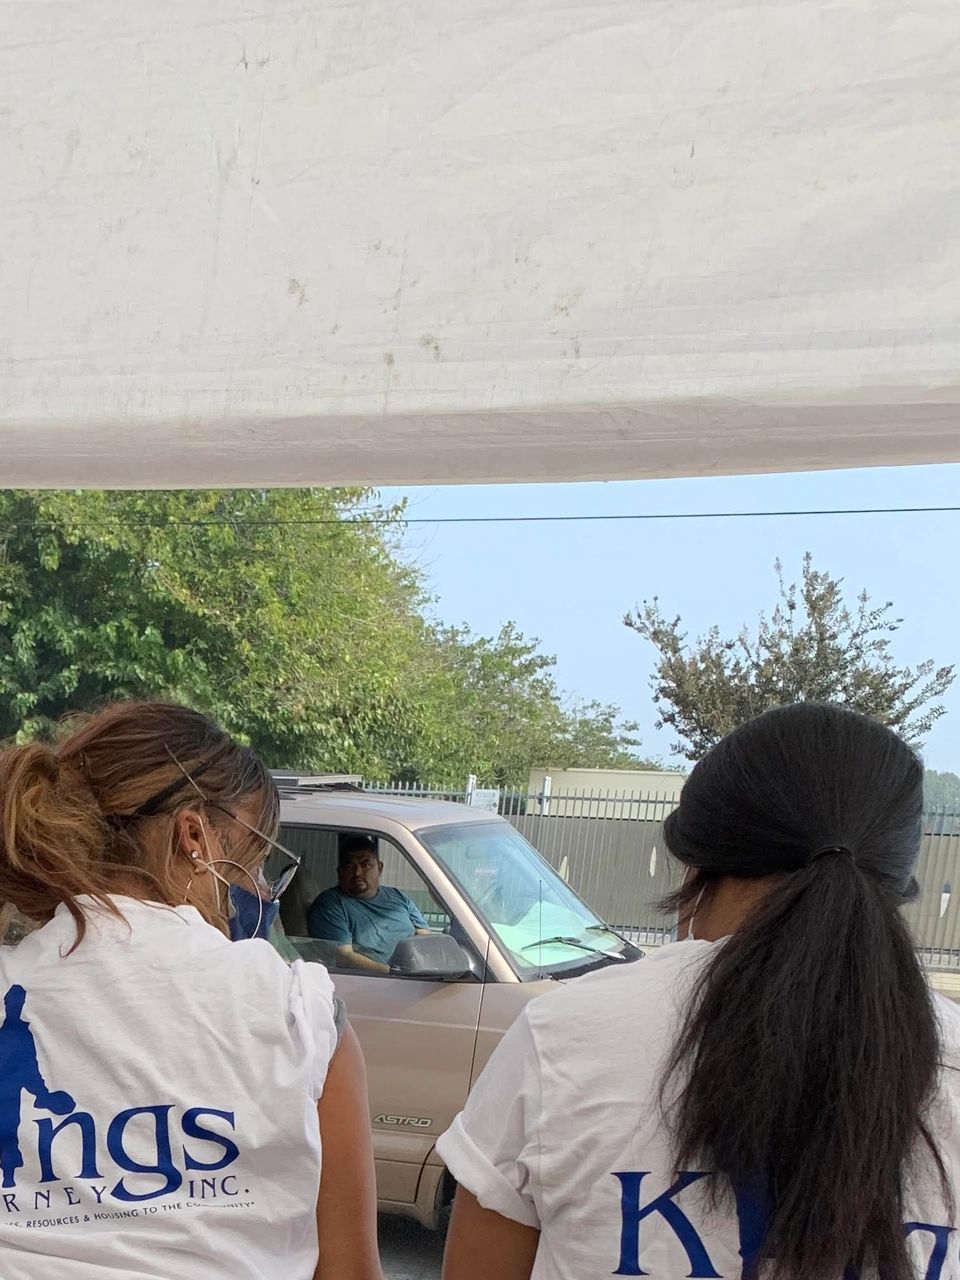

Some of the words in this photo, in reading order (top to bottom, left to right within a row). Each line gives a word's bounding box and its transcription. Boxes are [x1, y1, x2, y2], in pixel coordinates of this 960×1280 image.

[373, 1114, 432, 1128] ASTRO
[188, 1175, 250, 1199] INC.
[26, 1213, 80, 1229] RESOURCES
[94, 1209, 139, 1221] HOUSING
[143, 1206, 158, 1215] TO
[162, 1202, 183, 1211] THE
